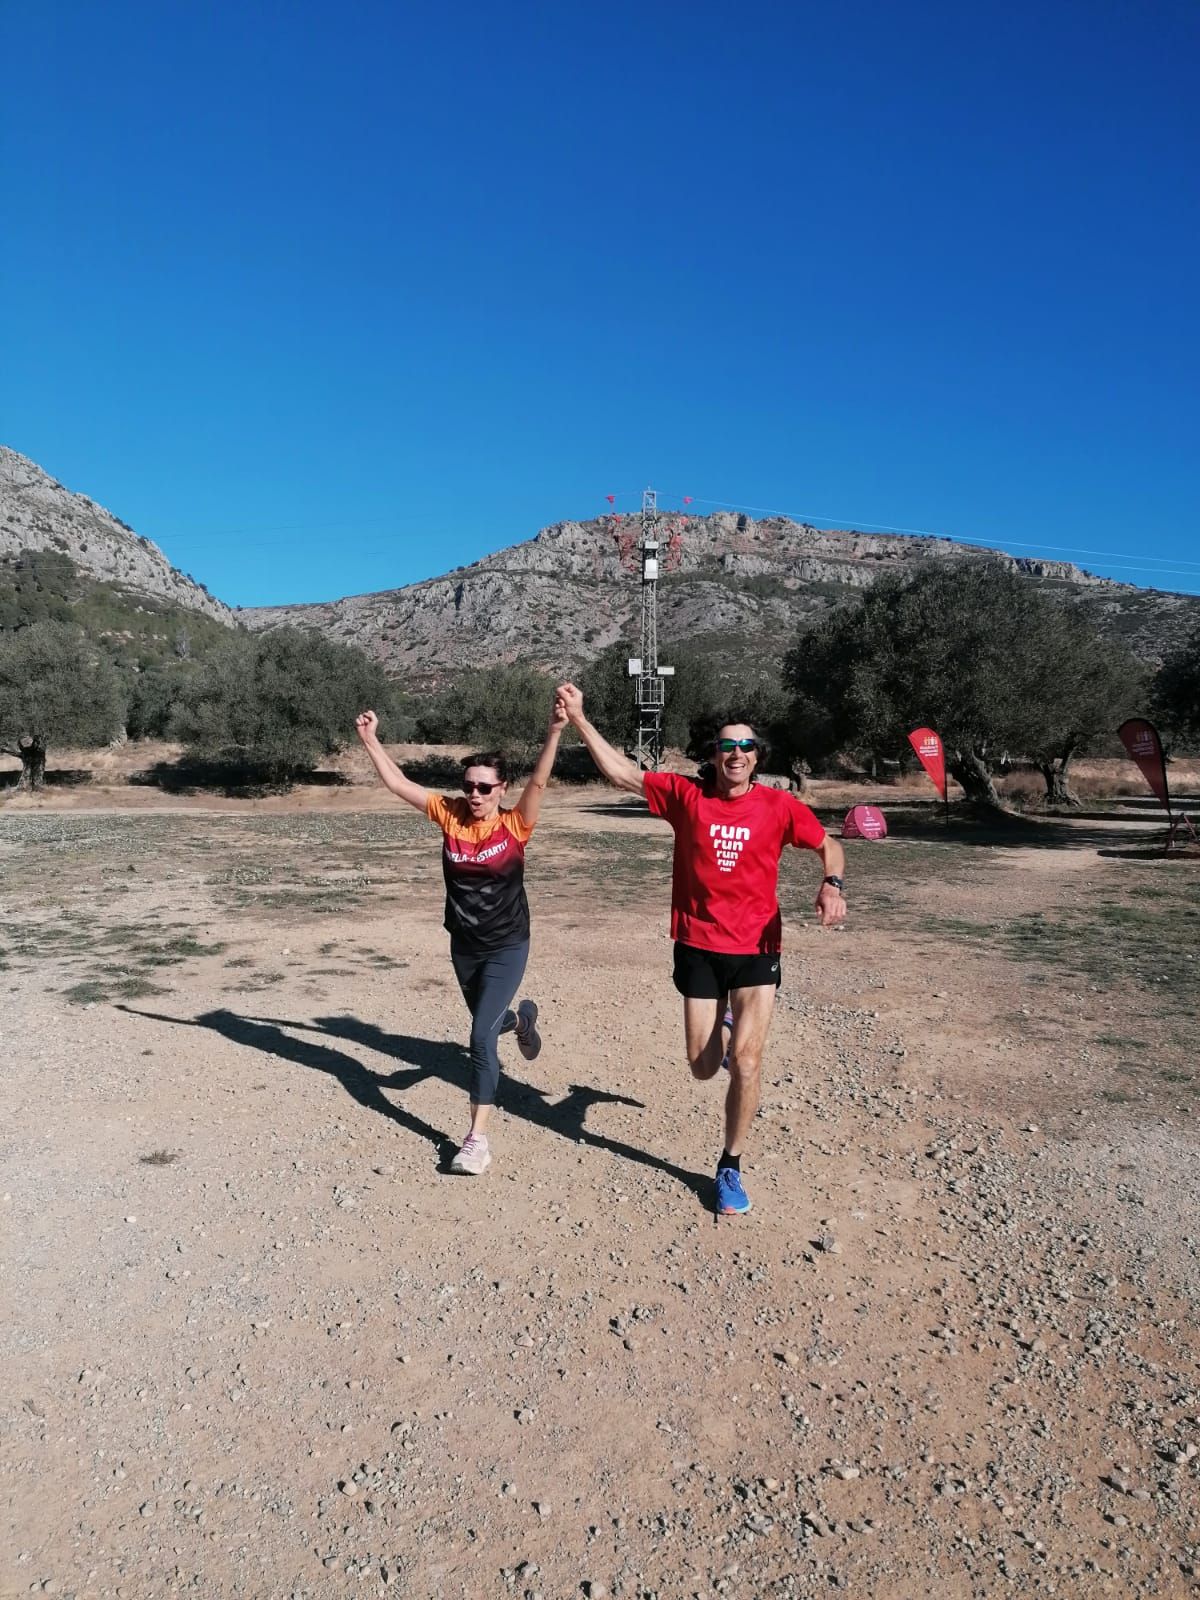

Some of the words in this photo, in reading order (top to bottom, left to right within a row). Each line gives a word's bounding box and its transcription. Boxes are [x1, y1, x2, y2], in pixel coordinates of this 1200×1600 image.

[710, 823, 750, 840] run
[713, 838, 744, 851] run
[716, 849, 739, 860] run
[717, 859, 736, 867] run
